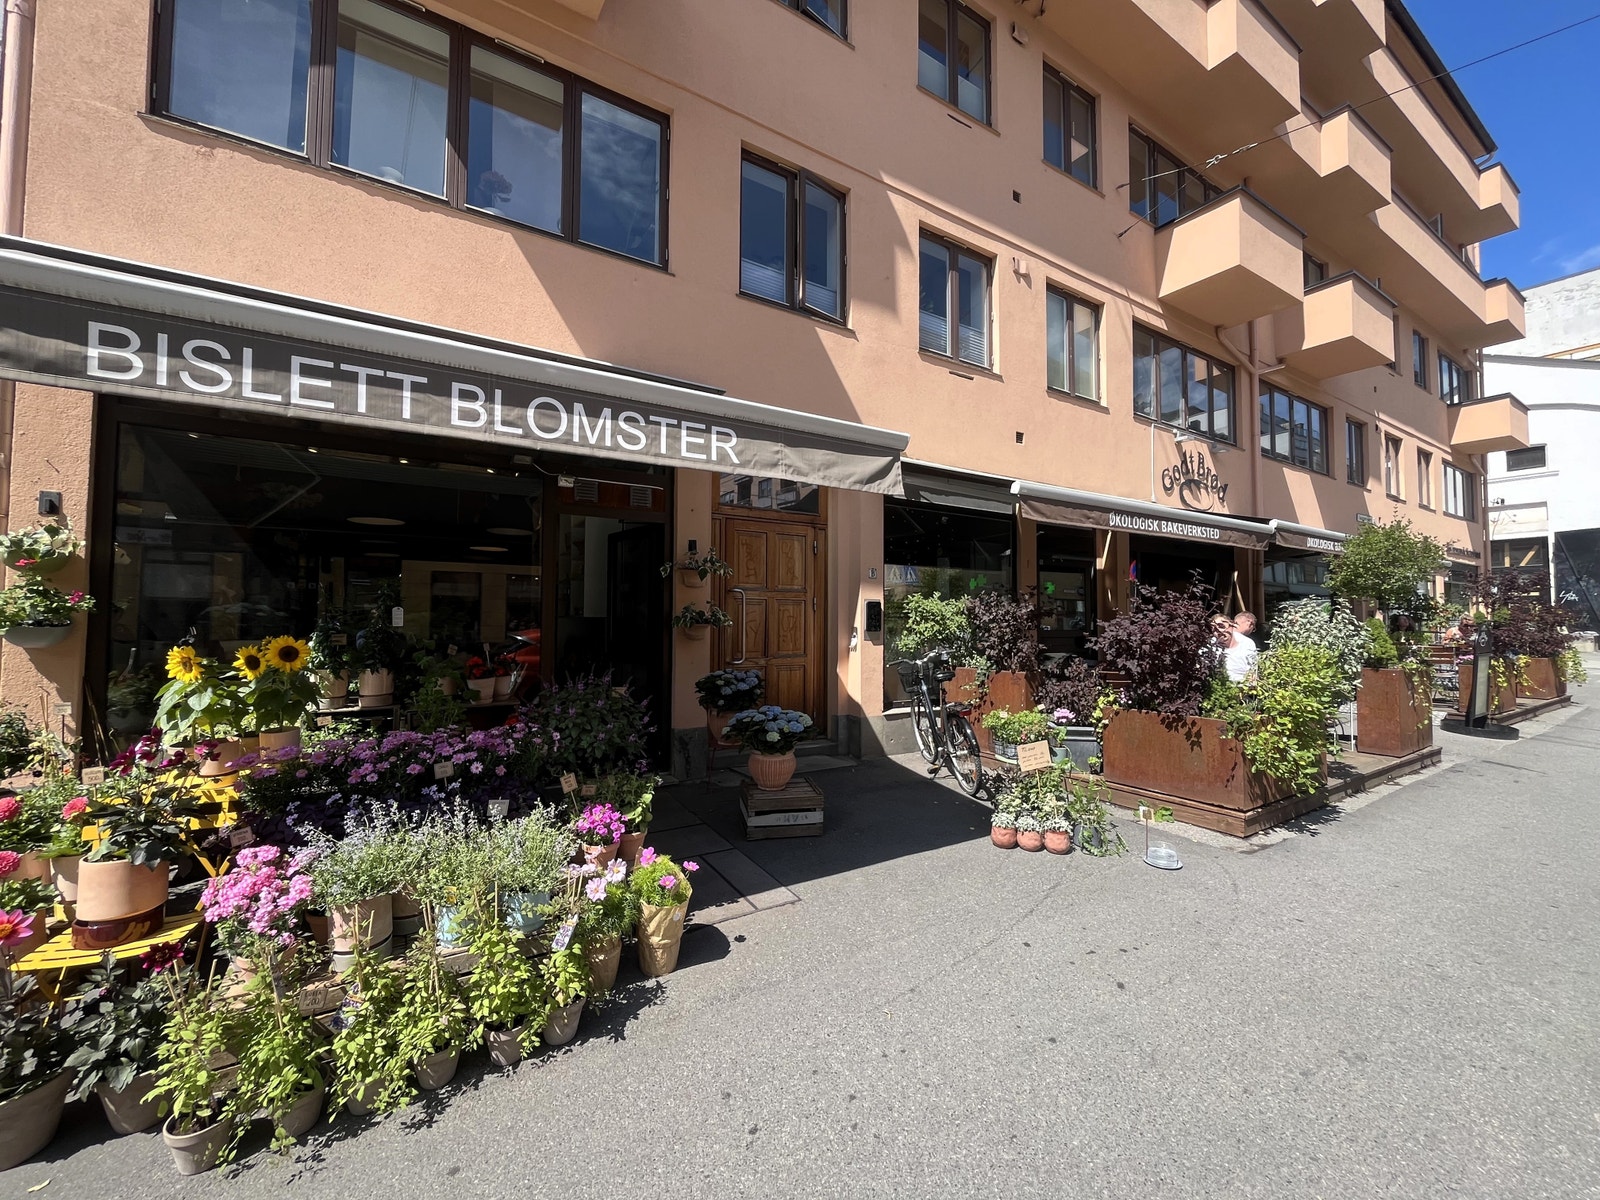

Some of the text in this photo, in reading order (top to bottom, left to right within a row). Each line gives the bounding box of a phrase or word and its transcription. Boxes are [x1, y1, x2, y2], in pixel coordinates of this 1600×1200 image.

[86, 320, 740, 465] BISLETT BLOMSTER
[1161, 450, 1195, 492] Godt
[1109, 512, 1220, 540] ØKOLOGISK BAKEVERKSTED
